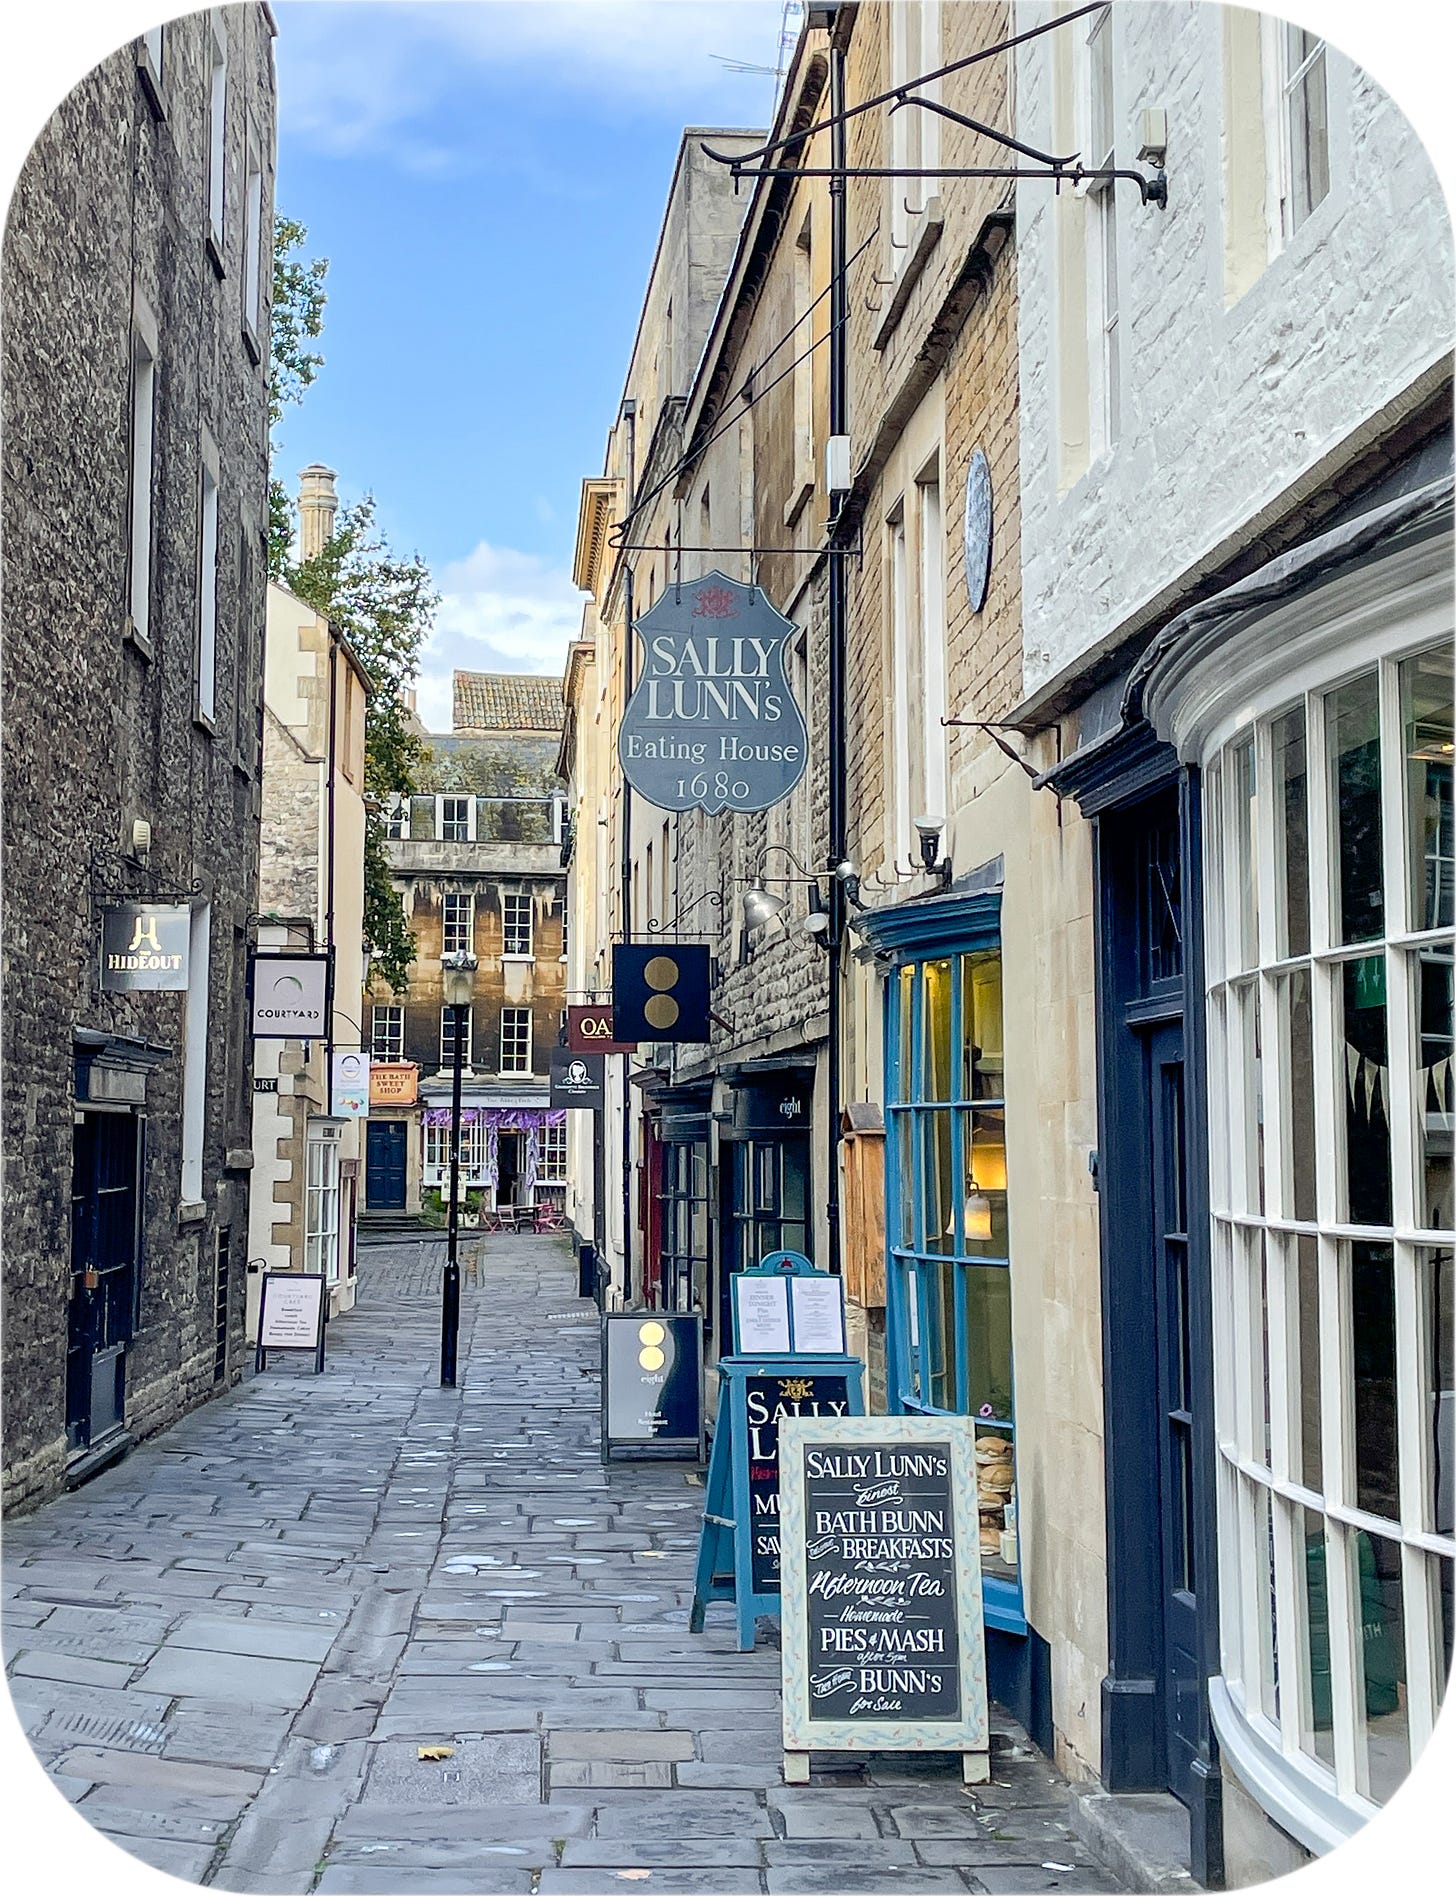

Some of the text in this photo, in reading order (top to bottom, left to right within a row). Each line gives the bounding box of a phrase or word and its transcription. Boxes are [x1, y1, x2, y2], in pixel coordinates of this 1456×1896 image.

[651, 635, 780, 678] SALLY
[626, 734, 799, 765] Eating House
[676, 771, 751, 799] 1680
[108, 954, 182, 970] HIDEOUT
[257, 1008, 320, 1020] COURTYARD
[580, 1017, 613, 1035] OA
[780, 1096, 801, 1119] eight
[807, 1451, 871, 1479] SALLY
[815, 1510, 944, 1534] BATH BUNN
[842, 1538, 954, 1560] BREAKFASTS
[809, 1570, 946, 1600] Afternoon Tea
[839, 1605, 905, 1624] Homemade
[820, 1627, 868, 1653] PIES
[878, 1628, 945, 1653] MASH
[857, 1651, 884, 1666] after
[850, 1696, 873, 1714] for
